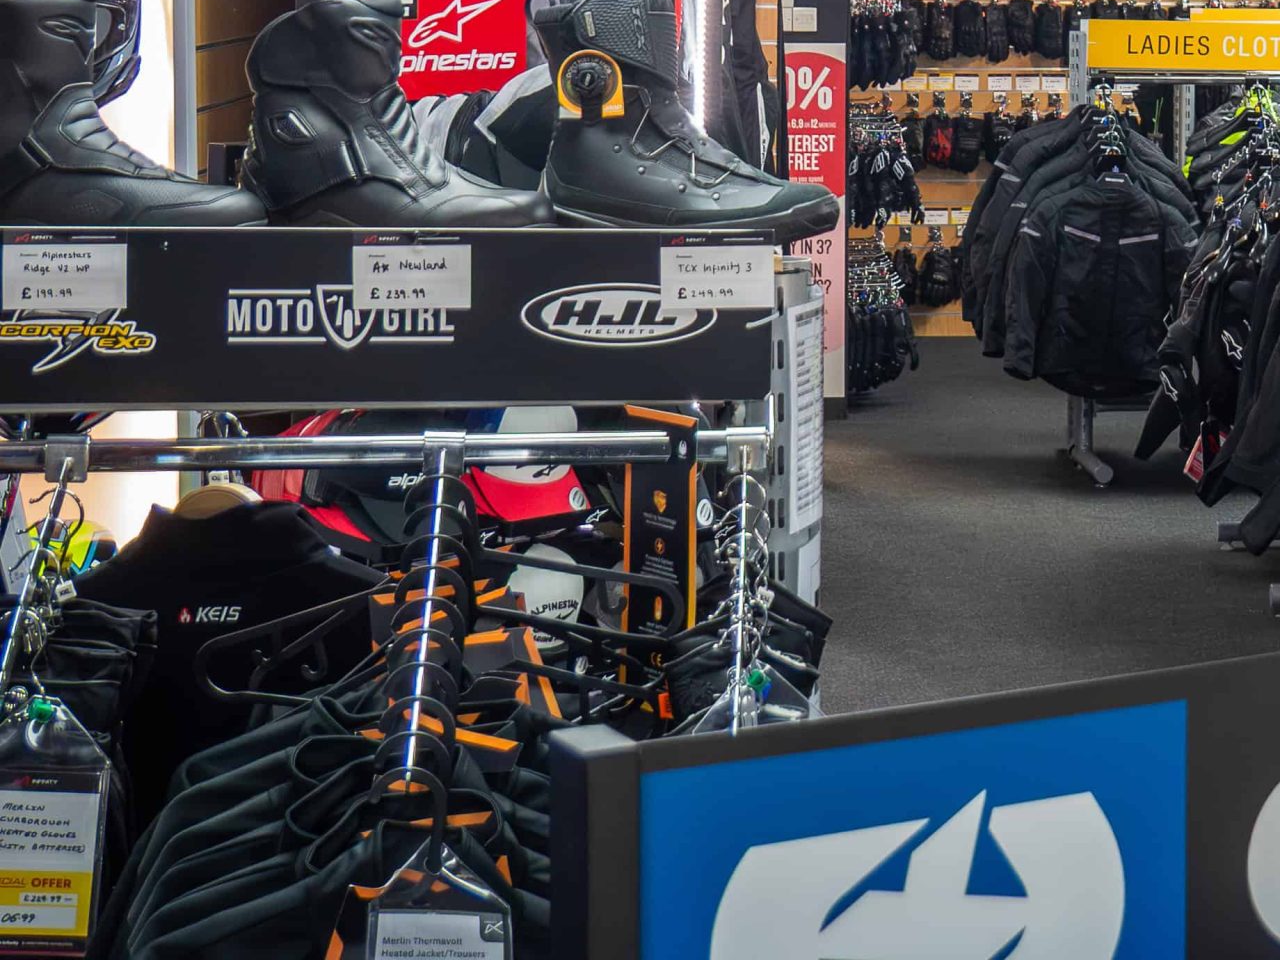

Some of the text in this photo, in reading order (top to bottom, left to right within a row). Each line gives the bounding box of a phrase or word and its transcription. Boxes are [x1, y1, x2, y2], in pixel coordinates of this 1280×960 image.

[1127, 34, 1211, 56] LADIES
[400, 49, 517, 75] pinestars
[788, 134, 836, 153] TEREST
[789, 153, 820, 171] FREE
[801, 239, 832, 255] IN 3?
[42, 247, 92, 262] Alpinestars
[24, 263, 91, 275] Ridge V2 WP
[399, 257, 448, 272] Newland
[677, 261, 753, 275] TCX Infinity 3
[36, 287, 73, 299] 199.99
[385, 287, 427, 299] 239.99
[691, 287, 735, 299] 249.99
[227, 298, 314, 333] MOTO
[0, 323, 131, 337] CORPION
[195, 606, 243, 623] KEIS
[2, 802, 46, 812] MERLIN
[41, 831, 77, 839] GLOVES
[31, 877, 72, 889] OFFER
[382, 936, 463, 946] Merlin Thermavolt
[381, 949, 486, 960] Heated Jacket/Trousers
